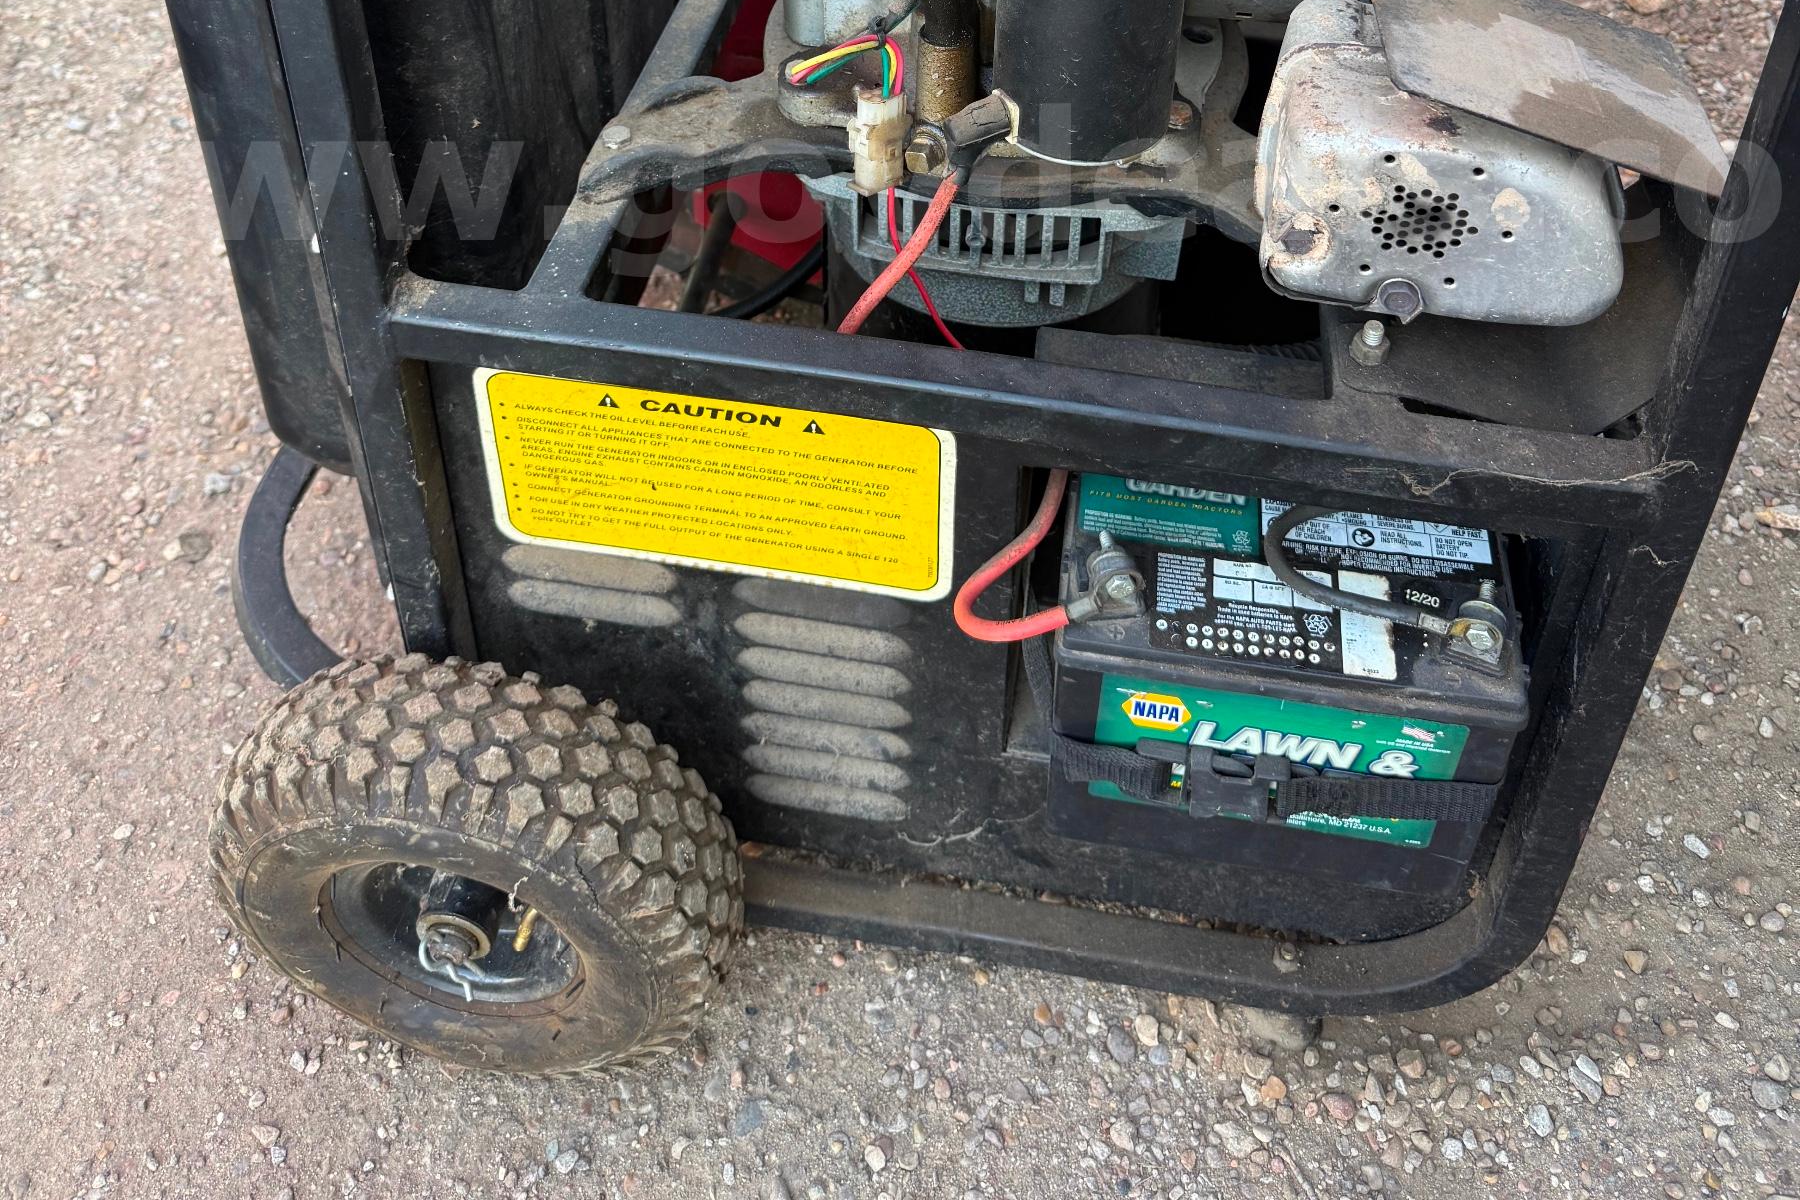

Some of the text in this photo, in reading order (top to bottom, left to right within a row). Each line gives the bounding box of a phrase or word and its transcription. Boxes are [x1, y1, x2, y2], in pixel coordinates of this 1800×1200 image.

[514, 402, 552, 413] ALWAYS
[554, 407, 587, 417] CHECK
[590, 412, 607, 420] THE
[610, 414, 625, 422] OIL
[626, 416, 655, 426] LEVEL
[659, 421, 698, 431] BEFORE
[700, 426, 726, 435] EACH
[640, 399, 782, 428] CAUTION
[516, 415, 577, 429] DISCONNECT
[580, 423, 598, 431] ALL
[601, 426, 661, 440] APPLIANCES
[666, 434, 689, 443] THAT
[691, 438, 712, 446] ARE
[714, 441, 774, 455] CONNECTED
[794, 451, 811, 459] THE
[814, 454, 874, 468] GENERATOR
[877, 463, 917, 474] BEFORE
[517, 423, 564, 434] STARTING
[593, 433, 636, 444] TURNING
[519, 435, 550, 445] NEVER
[553, 440, 574, 448] RUN
[577, 443, 594, 451] THE
[597, 446, 654, 459] GENERATOR
[658, 454, 701, 465] INDOORS
[733, 464, 785, 476] ENCLOSED
[788, 471, 827, 482] POORLY
[558, 448, 592, 458] ENGINE
[596, 453, 639, 464] EXHAUST
[644, 459, 691, 471] CONTAINS
[694, 466, 734, 477] CARBON
[811, 481, 862, 494] ODORLESS
[866, 489, 885, 497] AND
[1451, 528, 1465, 536] HELP
[1404, 588, 1440, 608] 12/20
[1133, 700, 1180, 722] NAPA
[1188, 721, 1419, 779] LAWN &
[1344, 821, 1368, 830] 21237
